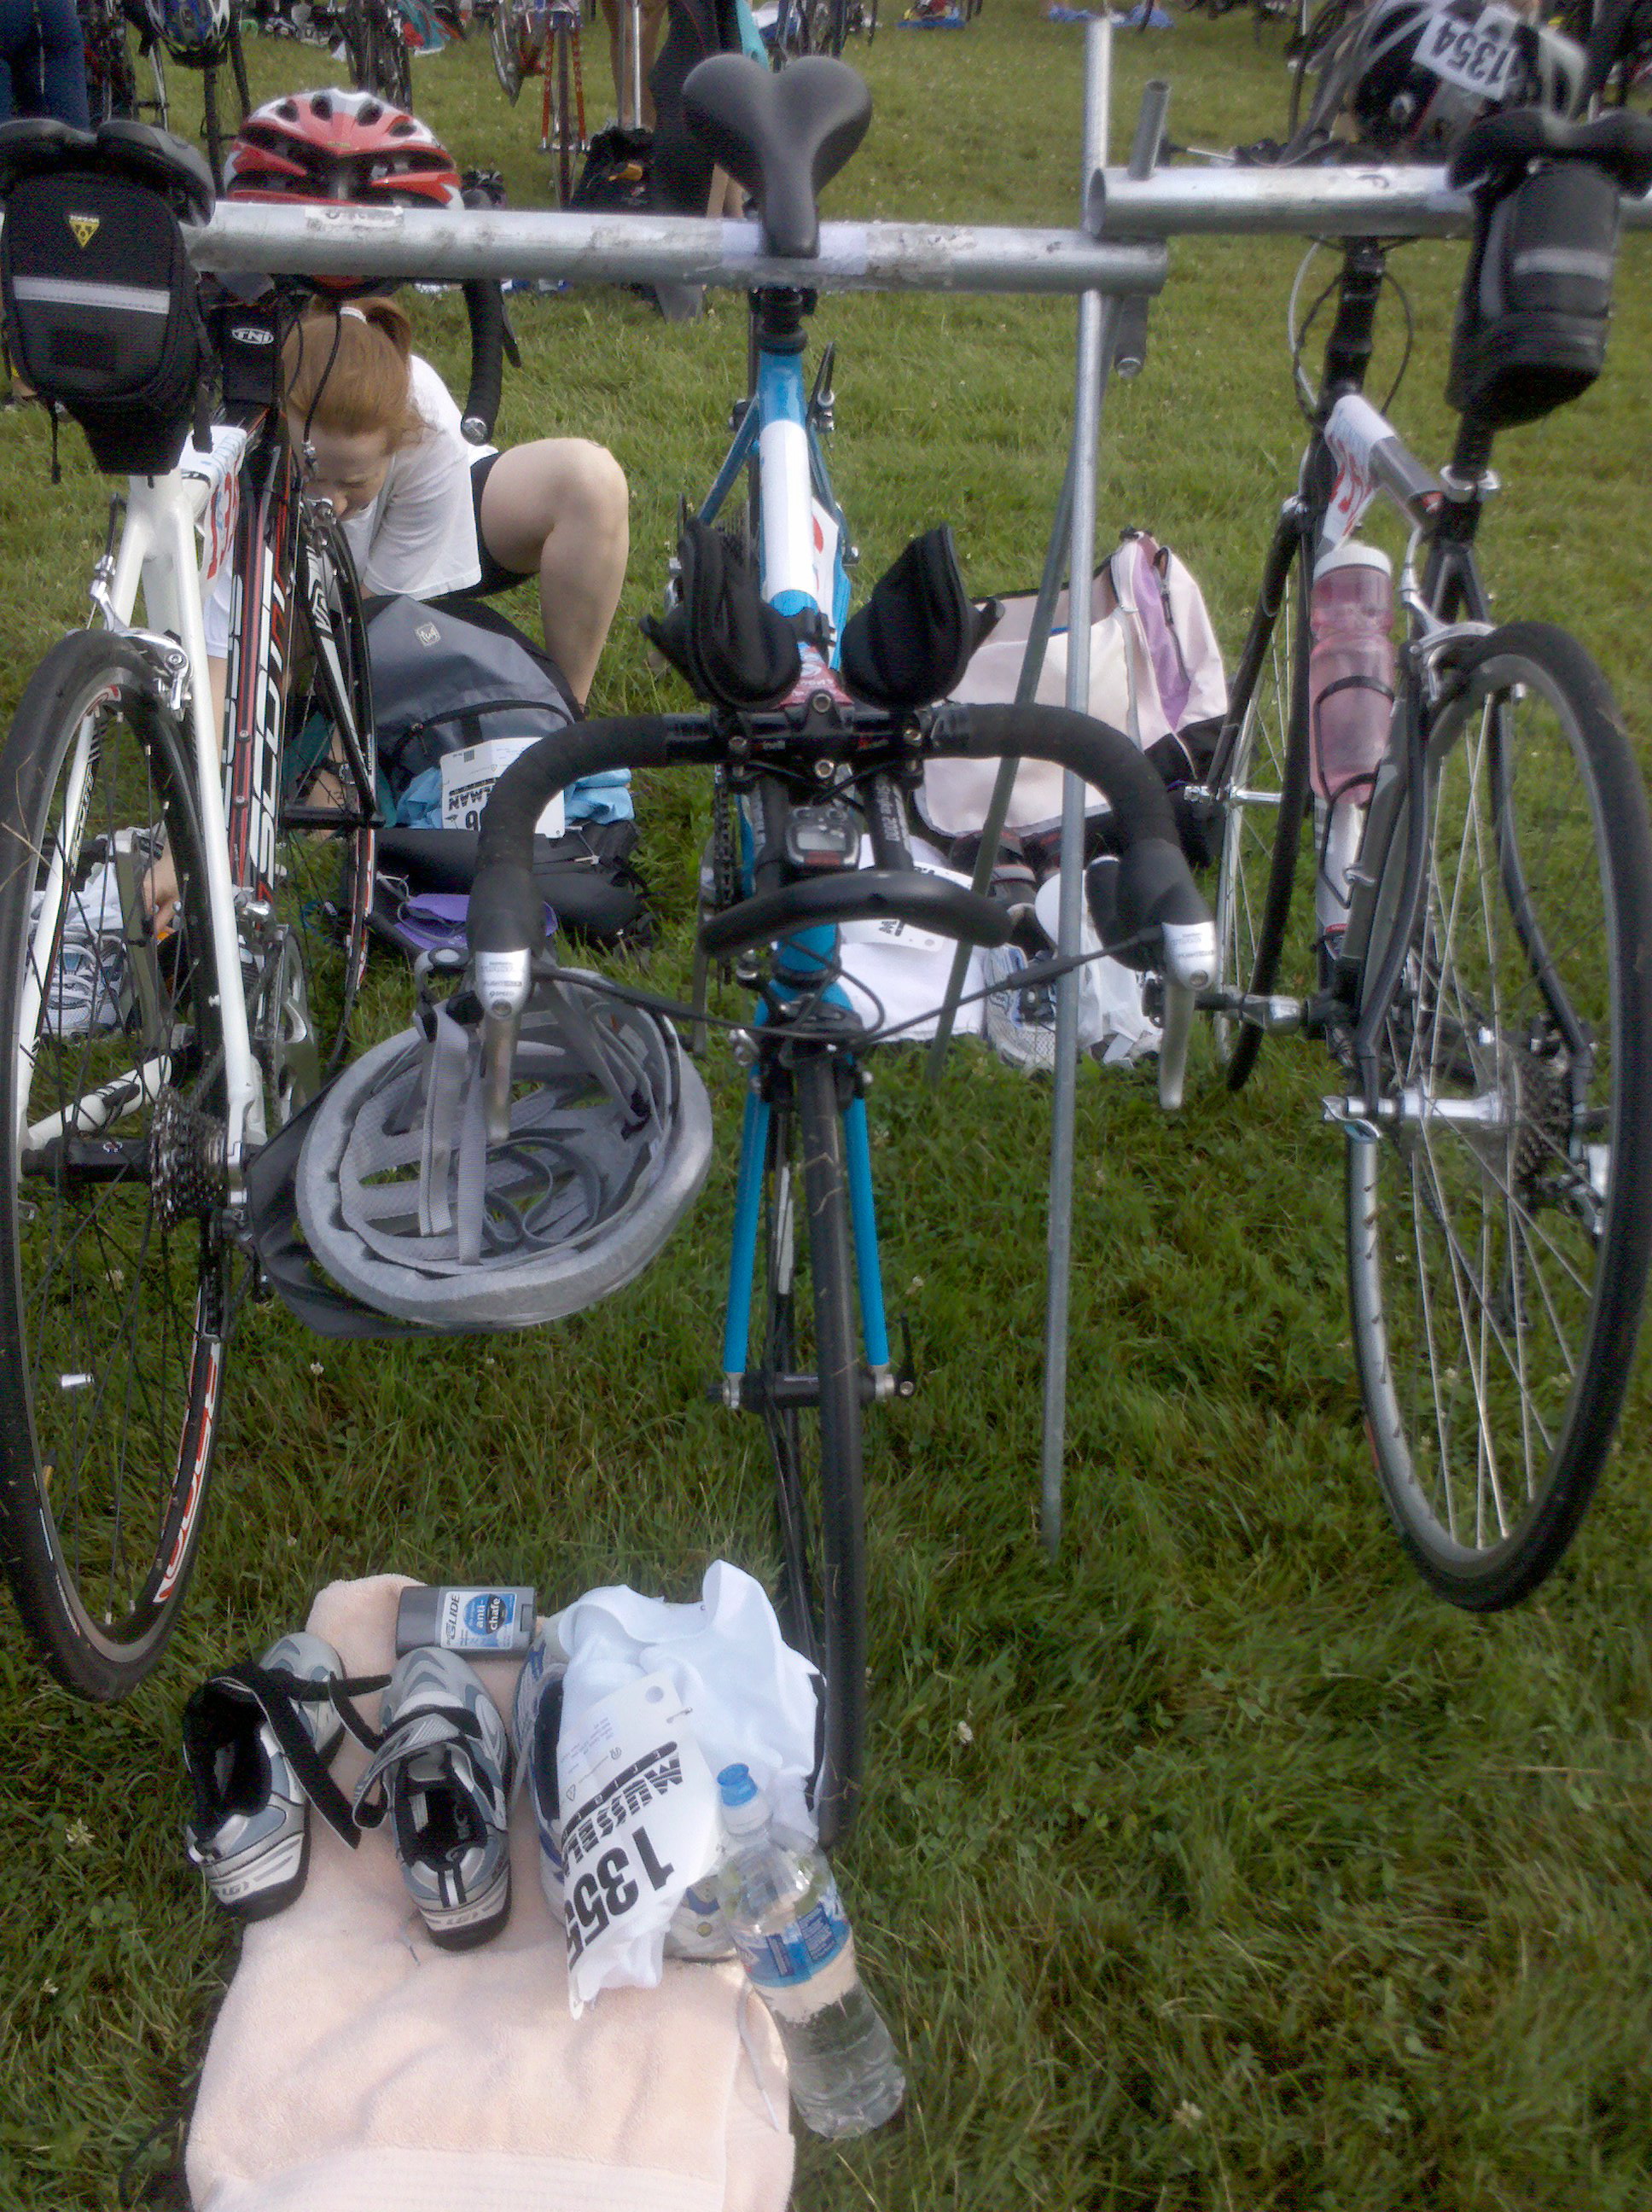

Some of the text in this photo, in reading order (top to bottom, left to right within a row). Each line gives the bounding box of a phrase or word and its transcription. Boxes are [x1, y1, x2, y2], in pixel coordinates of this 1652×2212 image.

[1432, 20, 1509, 84] 1354
[249, 547, 285, 889] SCOTT
[477, 1599, 486, 1628] anti-
[489, 1598, 502, 1631] chafe
